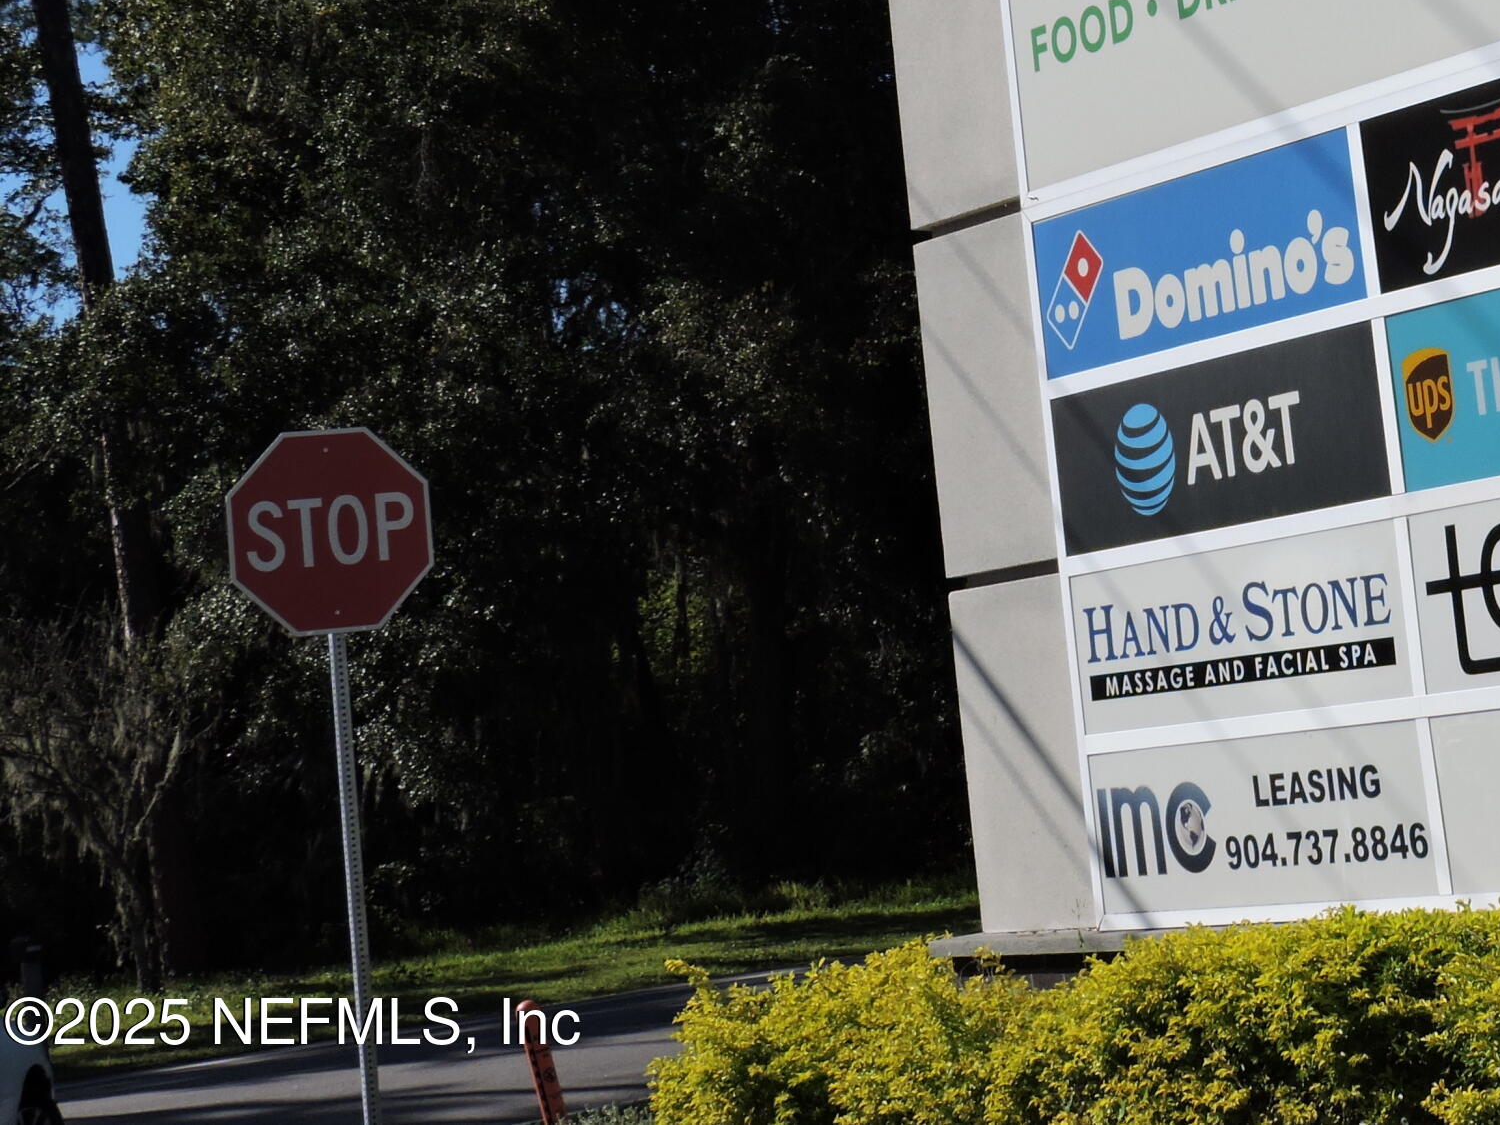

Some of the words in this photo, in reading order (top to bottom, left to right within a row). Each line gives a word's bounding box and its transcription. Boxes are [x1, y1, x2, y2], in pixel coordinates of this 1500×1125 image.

[1112, 209, 1355, 340] Domino's
[1407, 375, 1453, 428] ups
[1187, 390, 1301, 486] AT&T
[246, 491, 414, 573] STOP
[1082, 603, 1200, 664] HAND
[1208, 596, 1237, 646] &
[1242, 573, 1392, 642] STONE
[1105, 665, 1195, 698] MASSAGE
[1204, 660, 1245, 685] AND
[1255, 649, 1330, 678] FACIAL
[1339, 643, 1377, 669] SPA
[1252, 764, 1382, 808] LEASING
[1225, 822, 1430, 871] 904.737.8846
